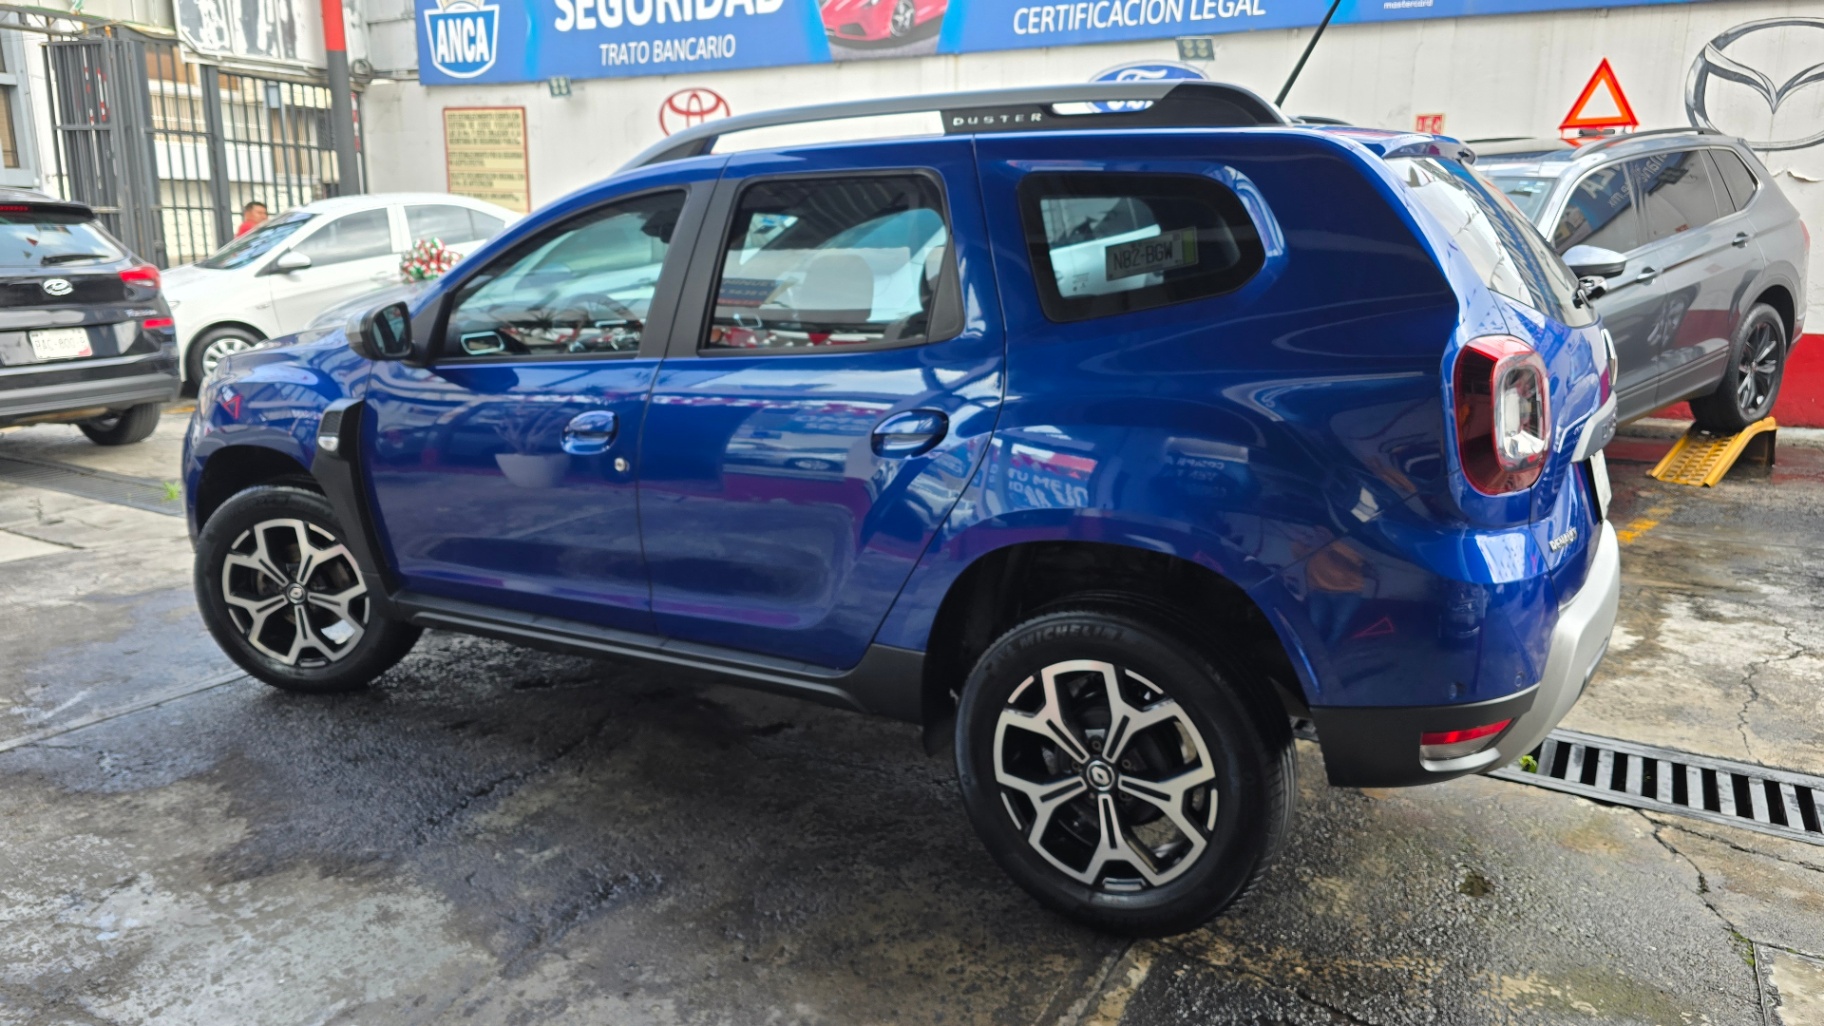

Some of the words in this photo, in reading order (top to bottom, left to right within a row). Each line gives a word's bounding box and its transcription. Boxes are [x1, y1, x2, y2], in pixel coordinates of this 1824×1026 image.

[554, 0, 784, 32] SEGUR
[1013, 0, 1183, 35] CERTIFICACION
[436, 16, 490, 63] ANCA
[599, 40, 650, 66] TRATO
[653, 34, 736, 63] BANCARIO
[952, 112, 1042, 126] DUSTER
